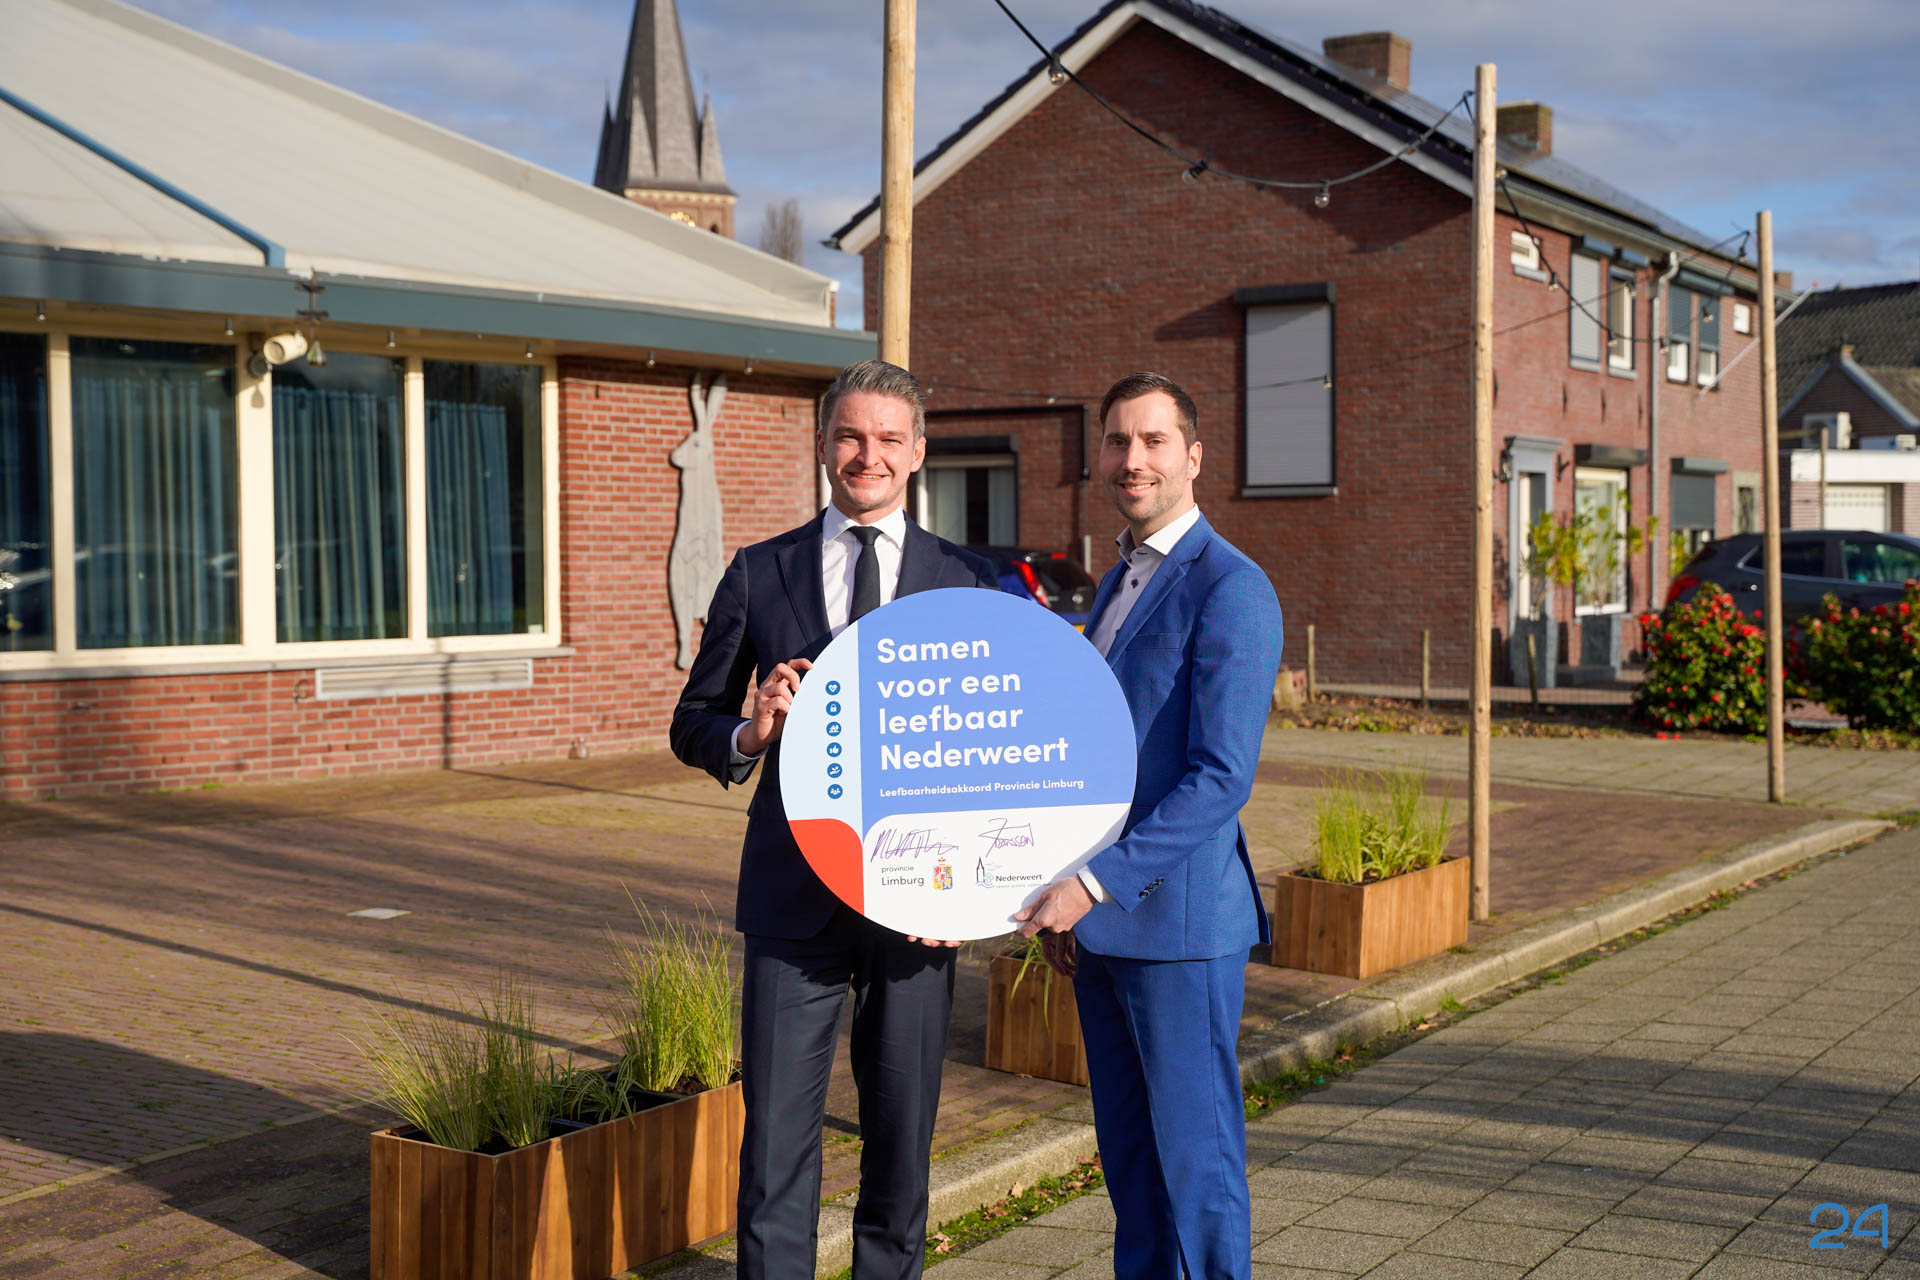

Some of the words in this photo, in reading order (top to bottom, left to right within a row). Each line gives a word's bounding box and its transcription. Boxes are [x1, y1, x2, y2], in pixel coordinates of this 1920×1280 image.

[877, 637, 990, 664] Samen
[877, 677, 951, 698] voor
[961, 673, 1021, 694] een
[879, 704, 1023, 735] leefbaar
[881, 737, 1068, 771] Nederweert
[880, 783, 992, 797] Leefbaarheidsakkoord
[994, 779, 1040, 792] Provincie
[1042, 778, 1085, 790] Limburg
[881, 865, 914, 873] provincie
[995, 873, 1043, 882] Nederweert
[881, 876, 924, 887] Limburg
